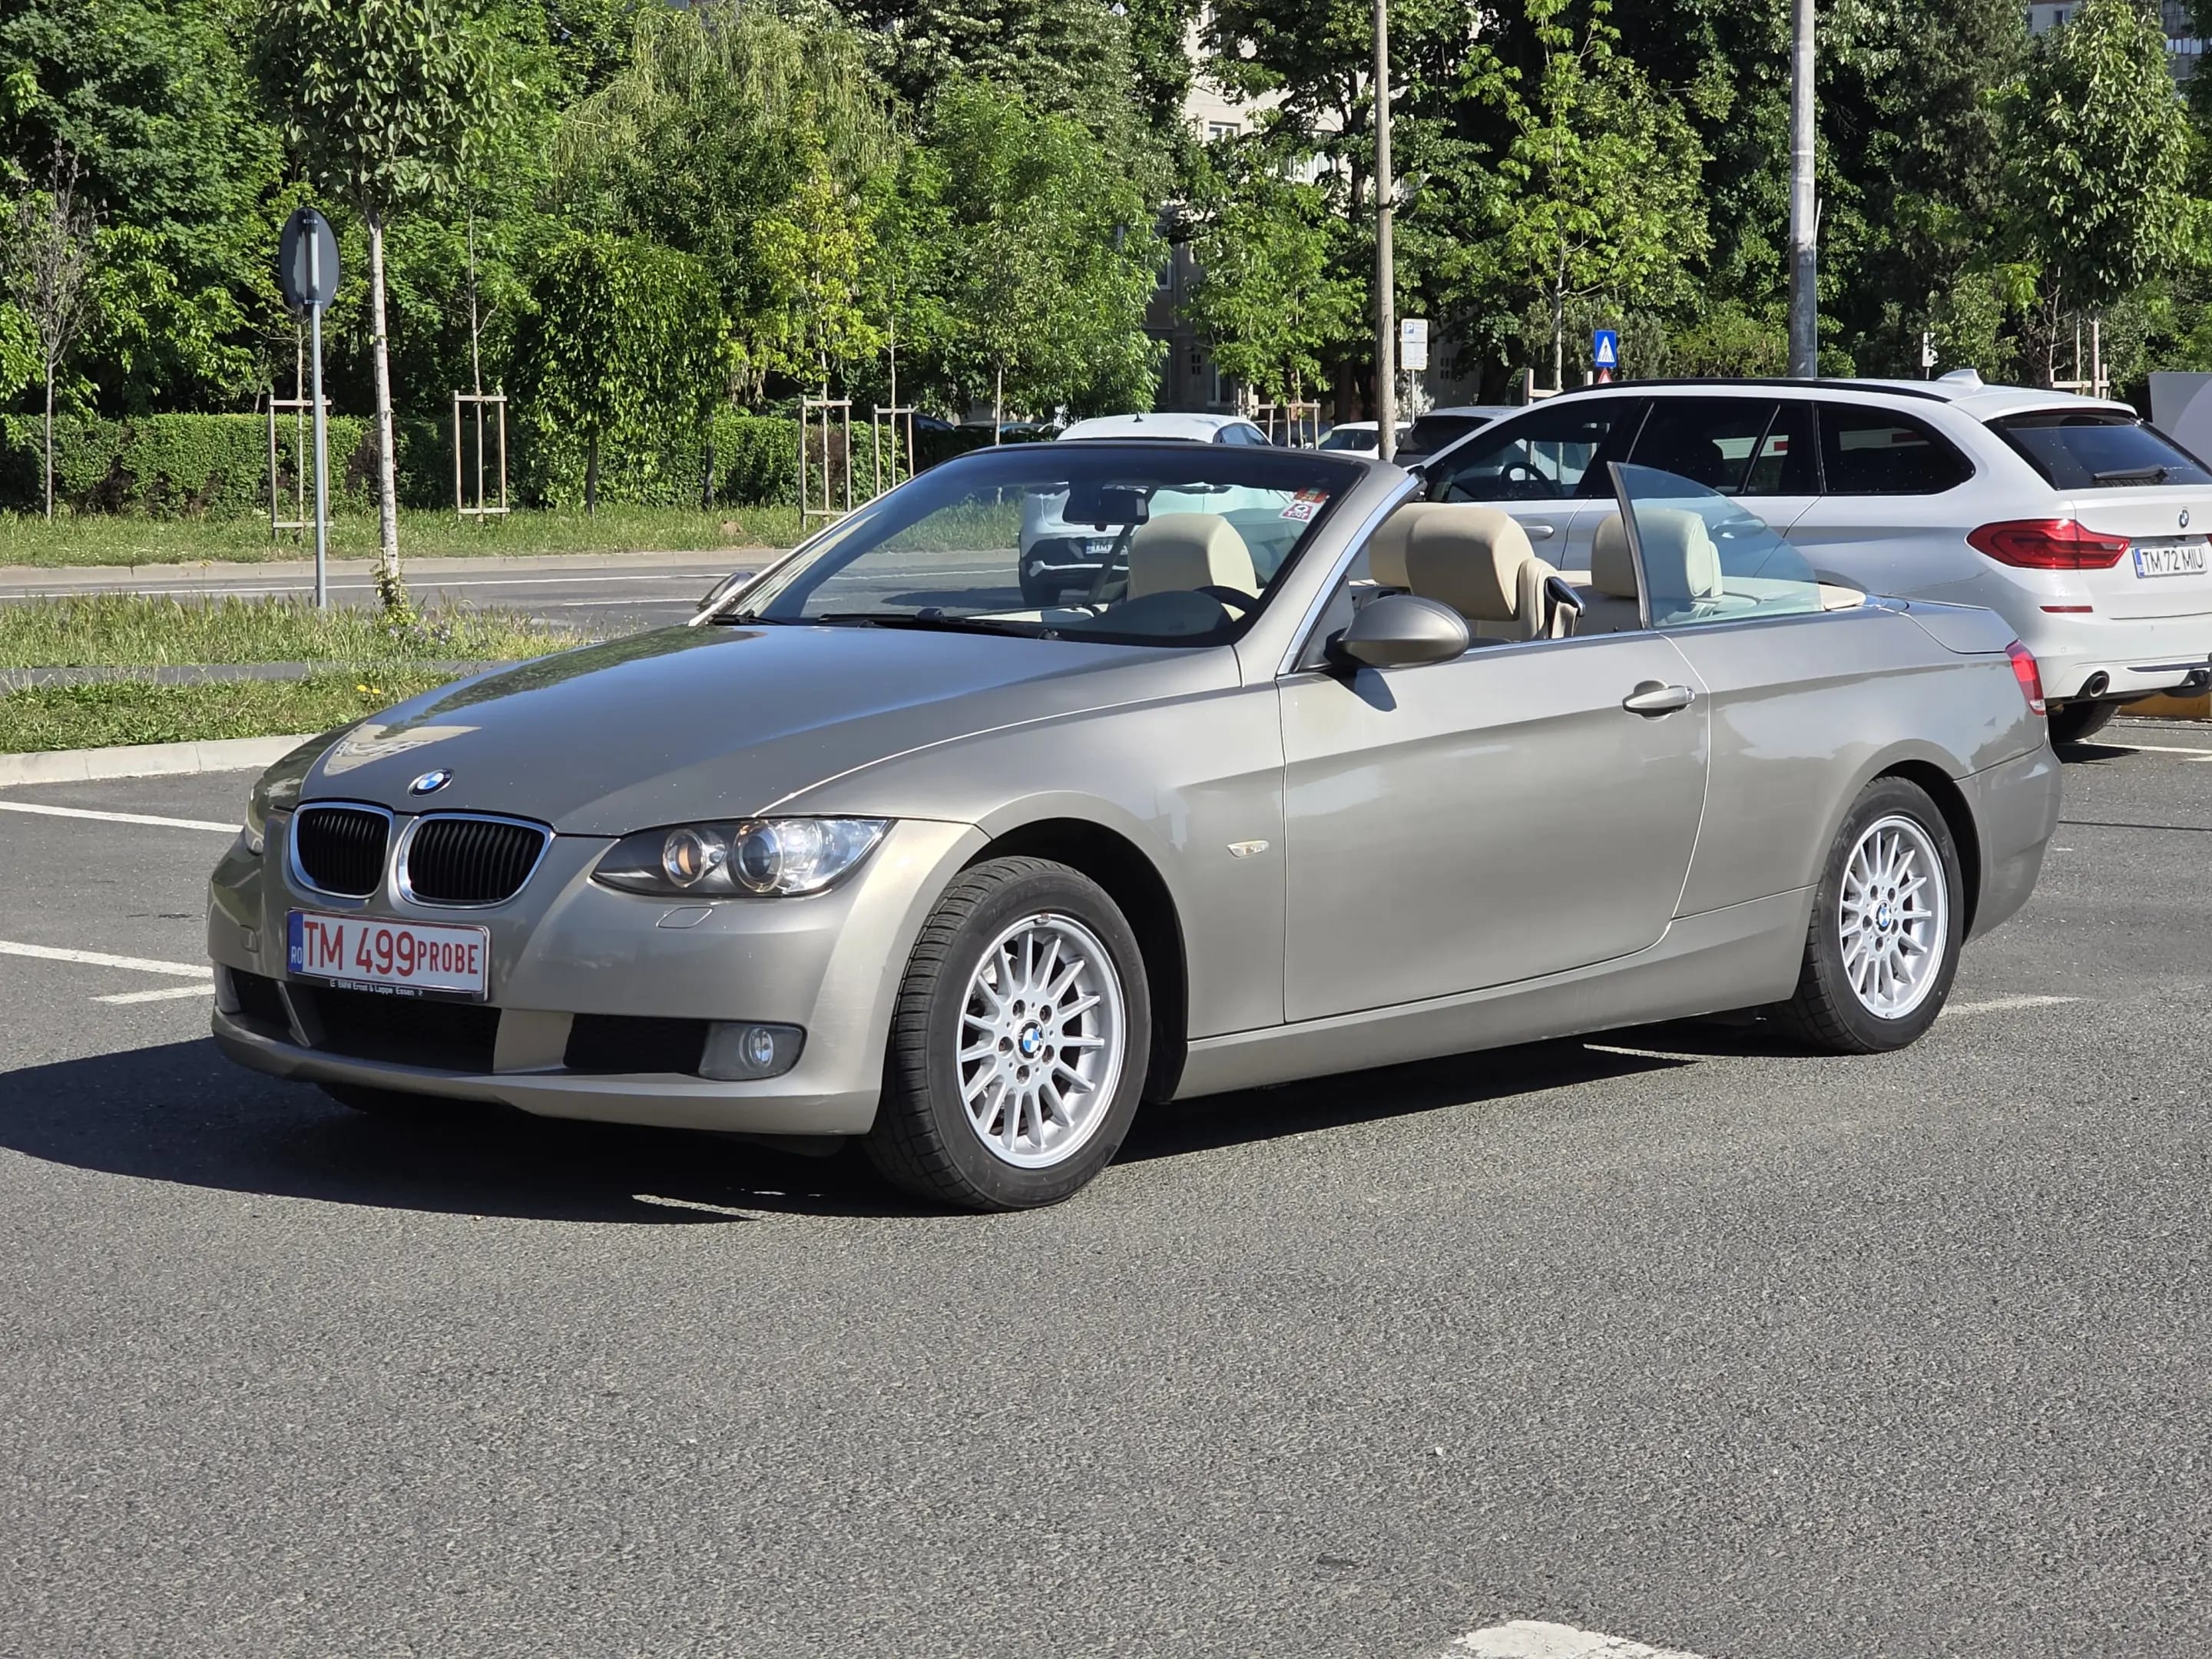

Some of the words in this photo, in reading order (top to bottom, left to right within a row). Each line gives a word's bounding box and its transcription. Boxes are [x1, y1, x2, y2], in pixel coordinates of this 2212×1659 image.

[1406, 323, 1413, 333] P
[2142, 551, 2162, 573] TM
[2164, 550, 2180, 571] 72
[2181, 548, 2204, 570] MIU
[291, 945, 303, 965] RO
[304, 921, 343, 971] TM
[356, 927, 415, 977] 499
[417, 941, 478, 975] PROBE
[396, 987, 414, 996] Essen
